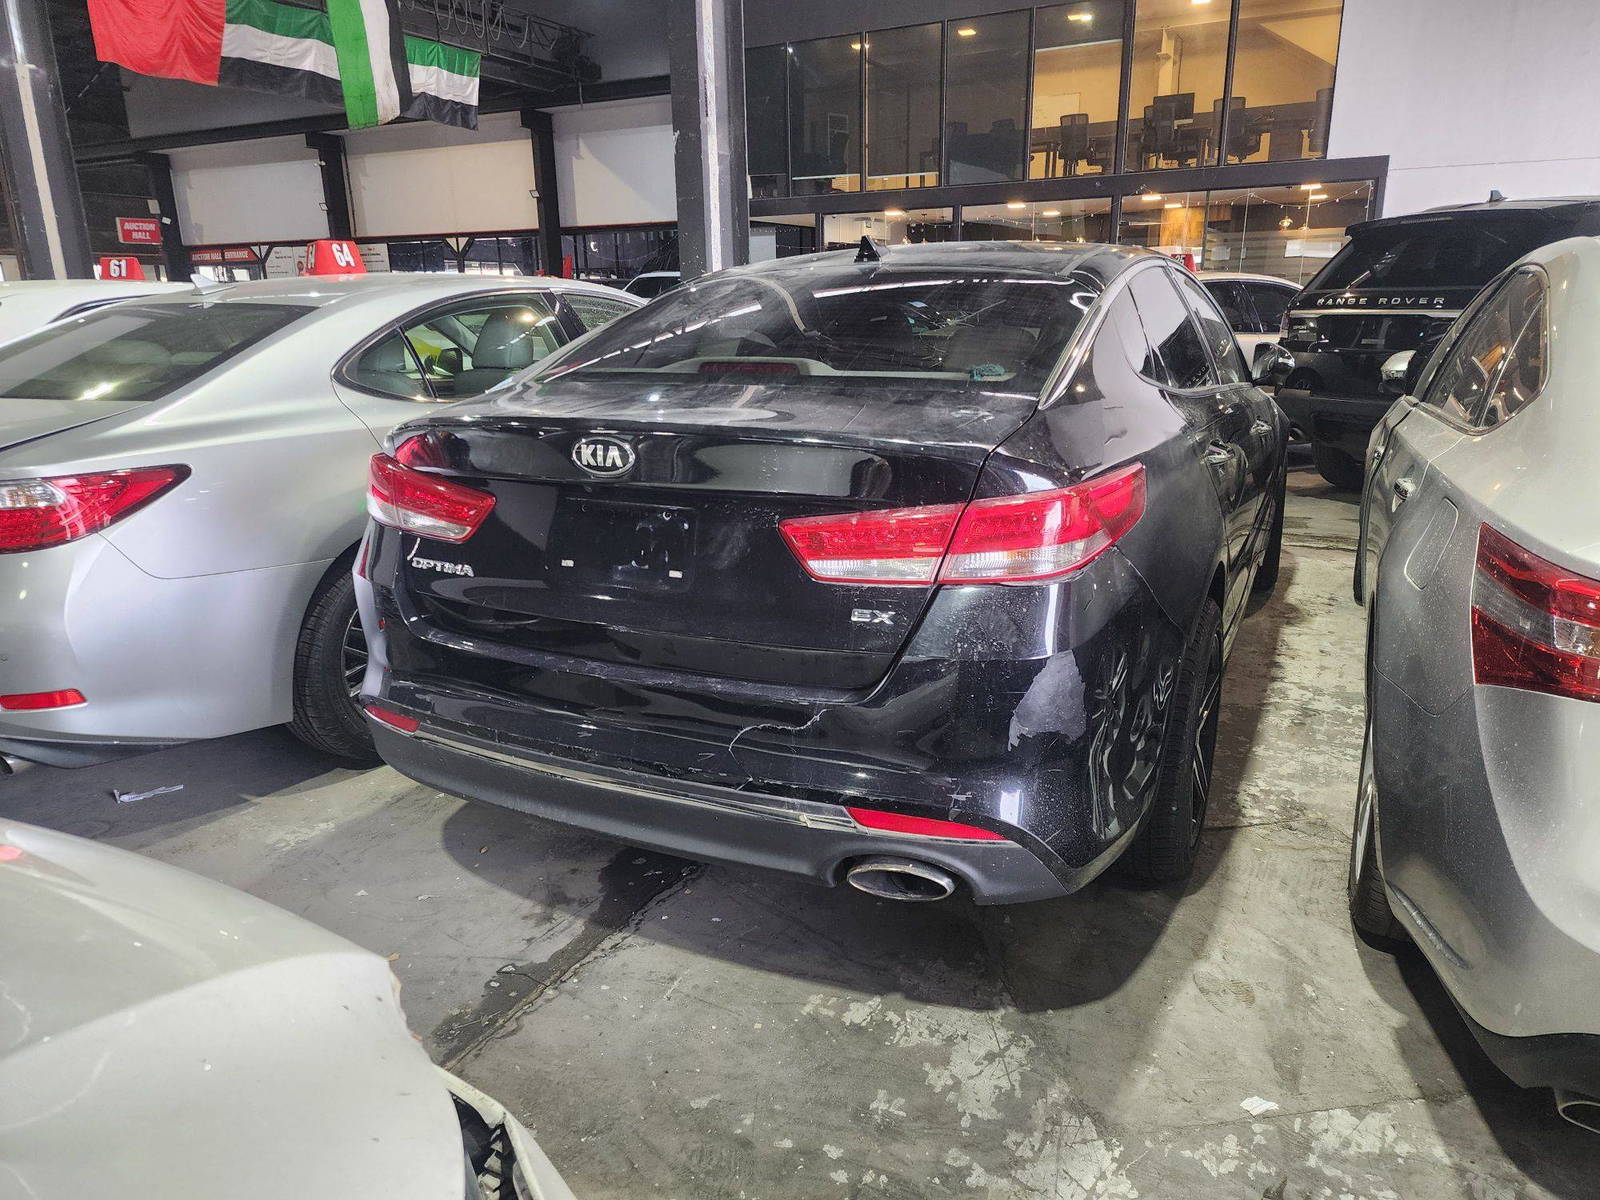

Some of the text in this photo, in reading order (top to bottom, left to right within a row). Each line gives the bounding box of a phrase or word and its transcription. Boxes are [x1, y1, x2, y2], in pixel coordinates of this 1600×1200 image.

[124, 222, 156, 231] AUCTION
[131, 231, 151, 240] HALL
[331, 243, 356, 268] 64
[109, 259, 127, 277] 61
[1316, 297, 1445, 305] RANGE ROVER
[581, 444, 623, 468] KIA
[411, 557, 475, 577] OPTIMA
[851, 608, 896, 625] EX
